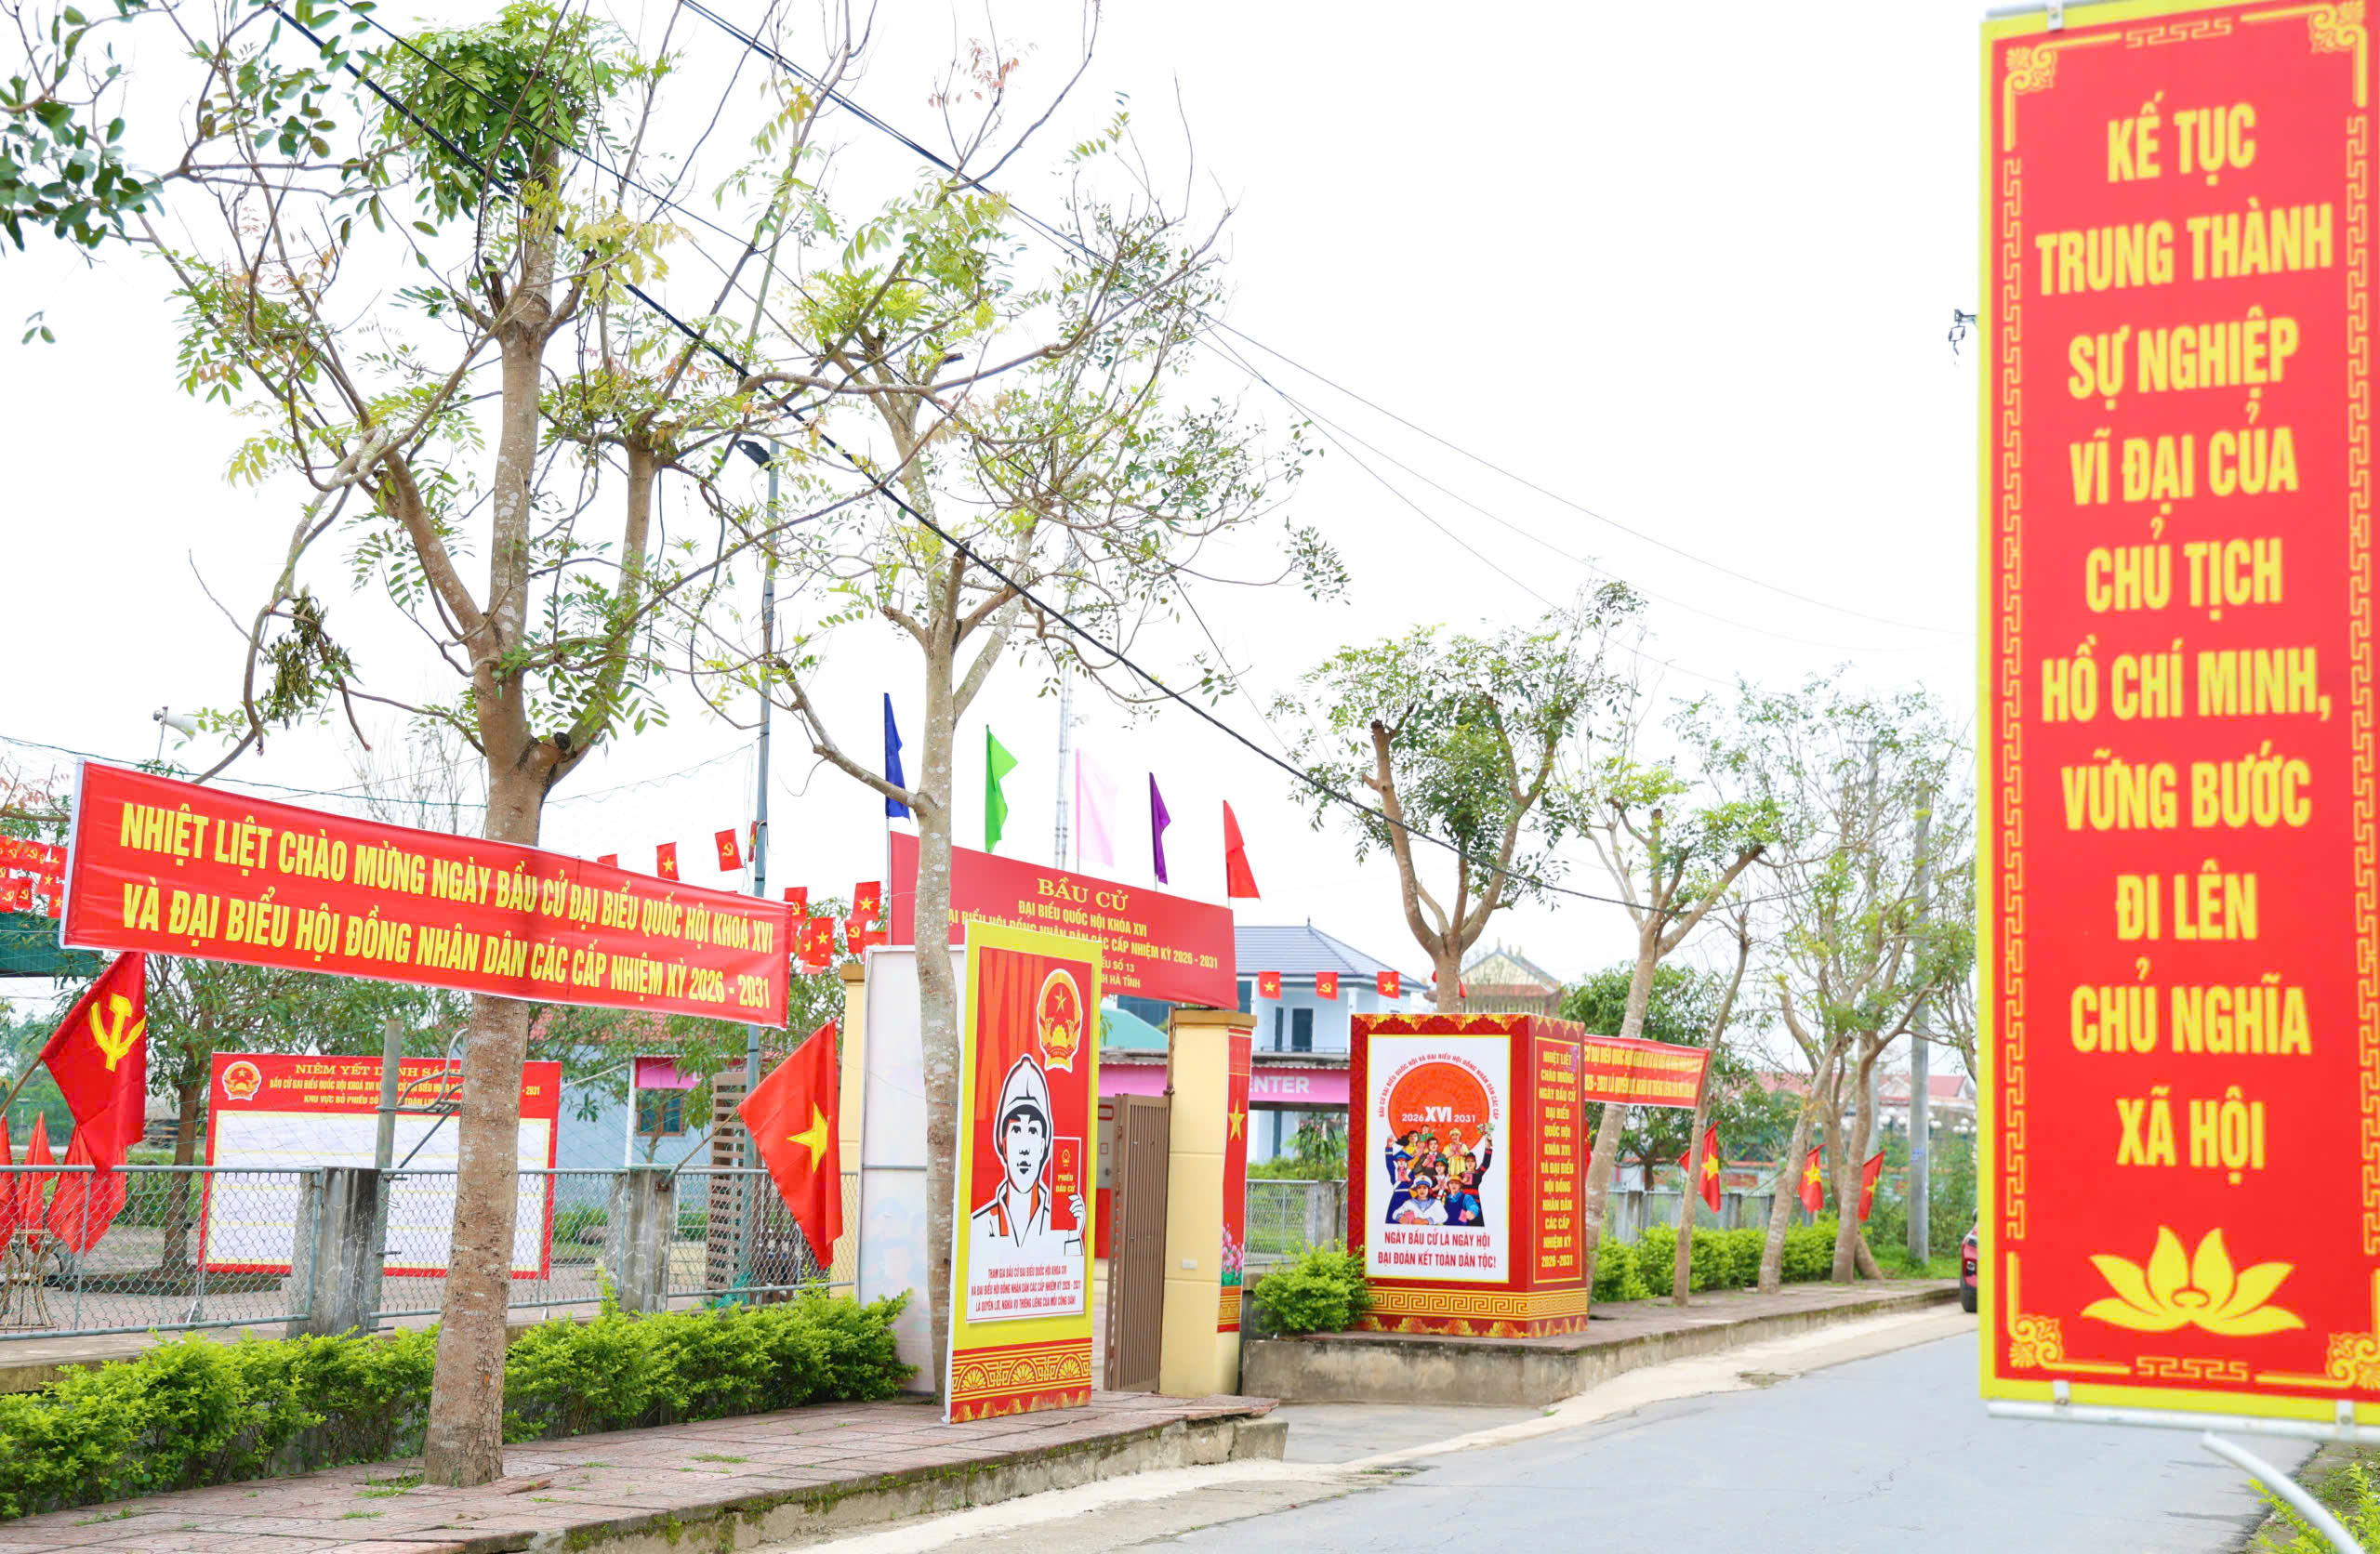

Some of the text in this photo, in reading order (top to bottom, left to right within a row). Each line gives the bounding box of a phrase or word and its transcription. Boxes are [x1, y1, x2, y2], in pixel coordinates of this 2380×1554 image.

[2108, 90, 2255, 186] KẾ TỤC
[2035, 197, 2333, 296] TRUNG THÀNH
[2068, 305, 2299, 411] SỰ NGHIỆP
[2069, 401, 2298, 515] VĨ ĐẠI CỦA
[2085, 516, 2283, 621] CHỦ TỊCH
[2042, 634, 2332, 722] HỒ CHÍ MINH,
[2061, 740, 2310, 830] VỮNG BƯỚC
[120, 803, 774, 954] NHIỆT LIỆT CHÀO MỪNG NGÀY BẦU CỬ ĐẠI BIỂU QUỐC HỘI KHOÁ XVI
[1018, 900, 1147, 938] ĐẠI BIỂU QUỐC HỘI KHÓA XVI
[1037, 876, 1130, 912] BẦU CỬ
[2116, 858, 2258, 941] ĐI LÊN
[123, 876, 161, 931] VÀ
[168, 889, 220, 947] ĐẠI
[225, 886, 290, 947] BIỂU
[295, 902, 340, 962] HỘI
[344, 905, 412, 963] ĐỒNG
[416, 923, 480, 972] NHÂN
[482, 928, 527, 978] DÂN
[531, 937, 567, 982] CÁC
[572, 940, 607, 988] CẤP
[611, 952, 663, 1002] NHIỆM
[666, 957, 686, 999] KỲ
[688, 969, 725, 1004] 2026
[738, 975, 771, 1009] 2031
[948, 908, 959, 926] ẠI
[1199, 955, 1218, 968] 2031
[2070, 957, 2312, 1055] CHỦ NGHĨA
[375, 1067, 418, 1077] DNH
[1250, 1075, 1310, 1093] NTER
[1401, 1106, 1476, 1123] 2026 XVI 2031
[2115, 1086, 2265, 1185] XÃ HỘI
